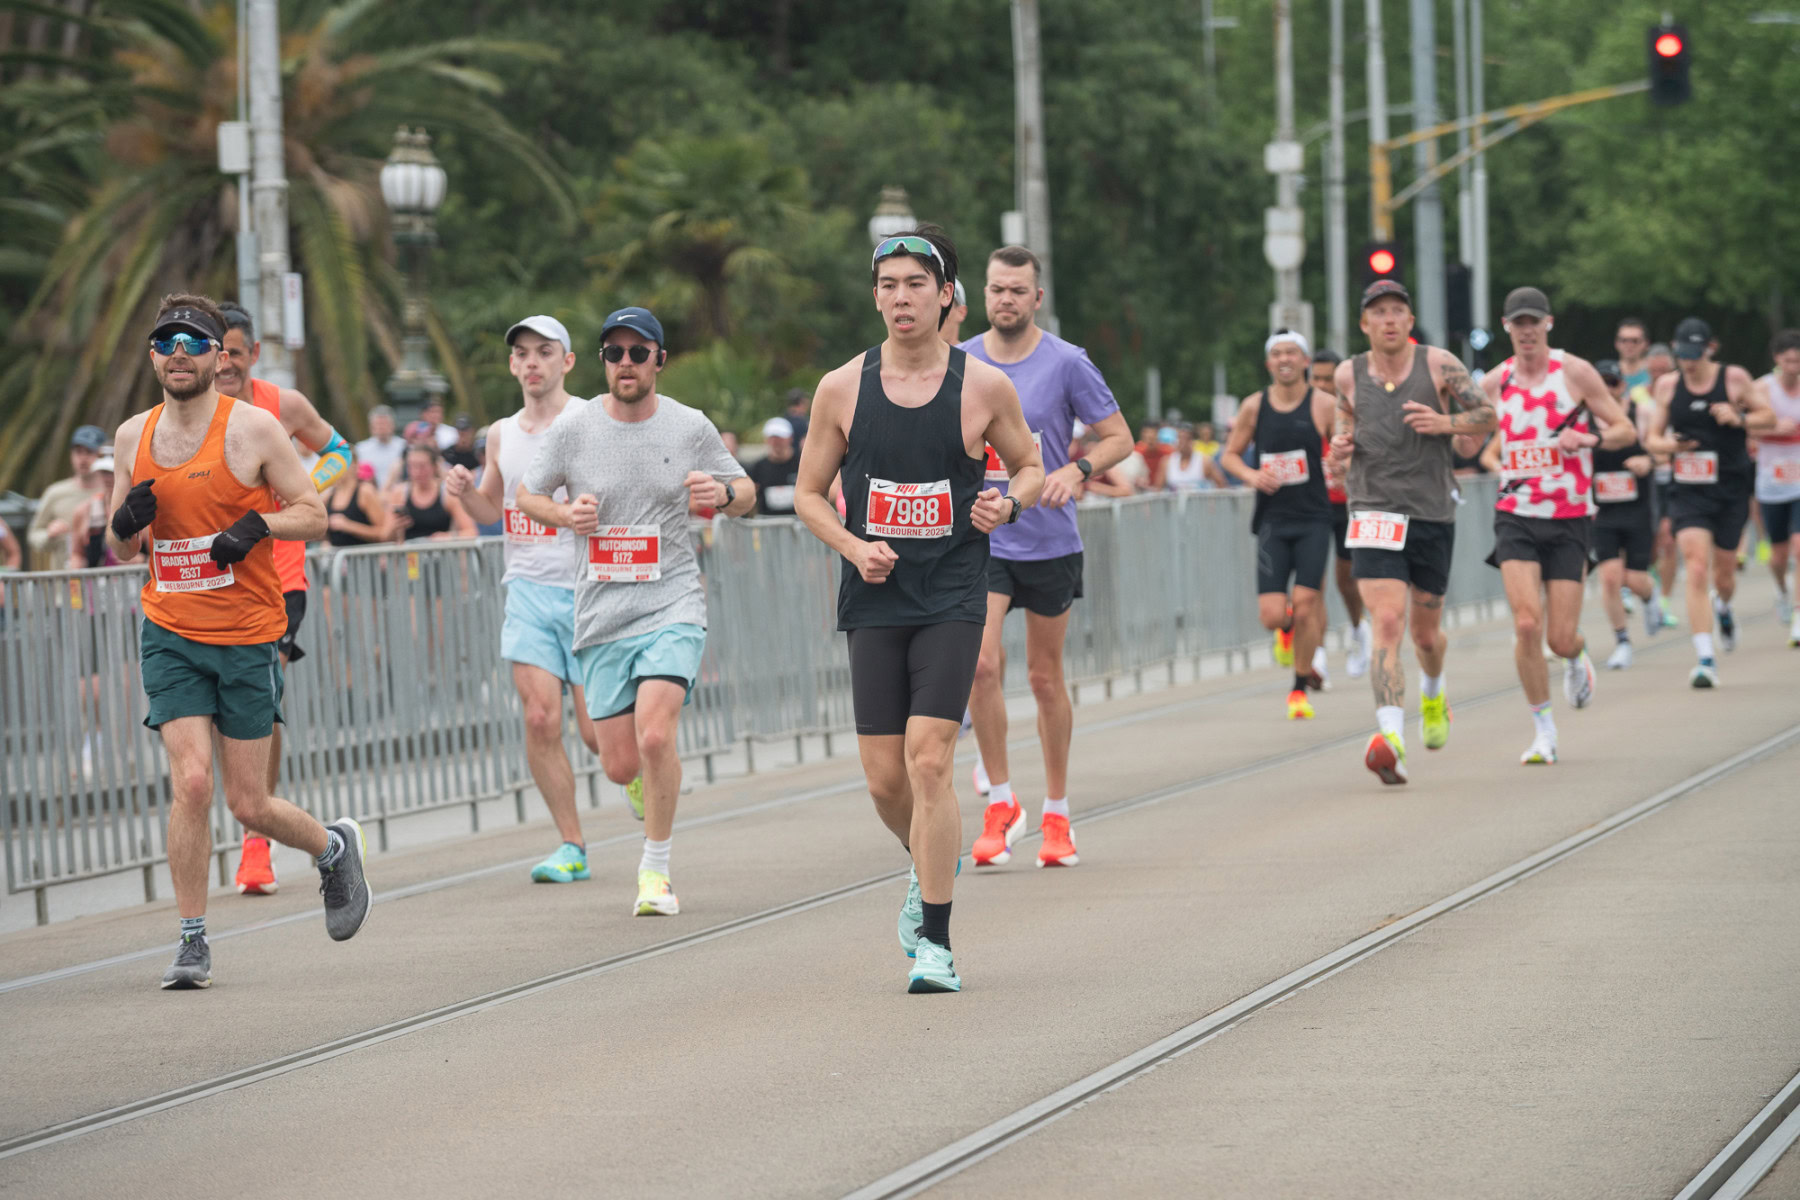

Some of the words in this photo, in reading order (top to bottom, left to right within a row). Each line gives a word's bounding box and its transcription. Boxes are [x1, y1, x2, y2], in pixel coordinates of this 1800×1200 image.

[884, 495, 939, 525] 7988
[875, 525, 923, 536] MELBOURNE
[925, 527, 945, 537] 2025
[1359, 519, 1395, 540] 9610
[598, 539, 648, 552] HUTCHINSON
[161, 555, 189, 567] BRADEN
[612, 551, 634, 564] 5172
[179, 566, 201, 579] 2537
[164, 581, 204, 590] MELBOURNE
[206, 576, 226, 587] 2025
